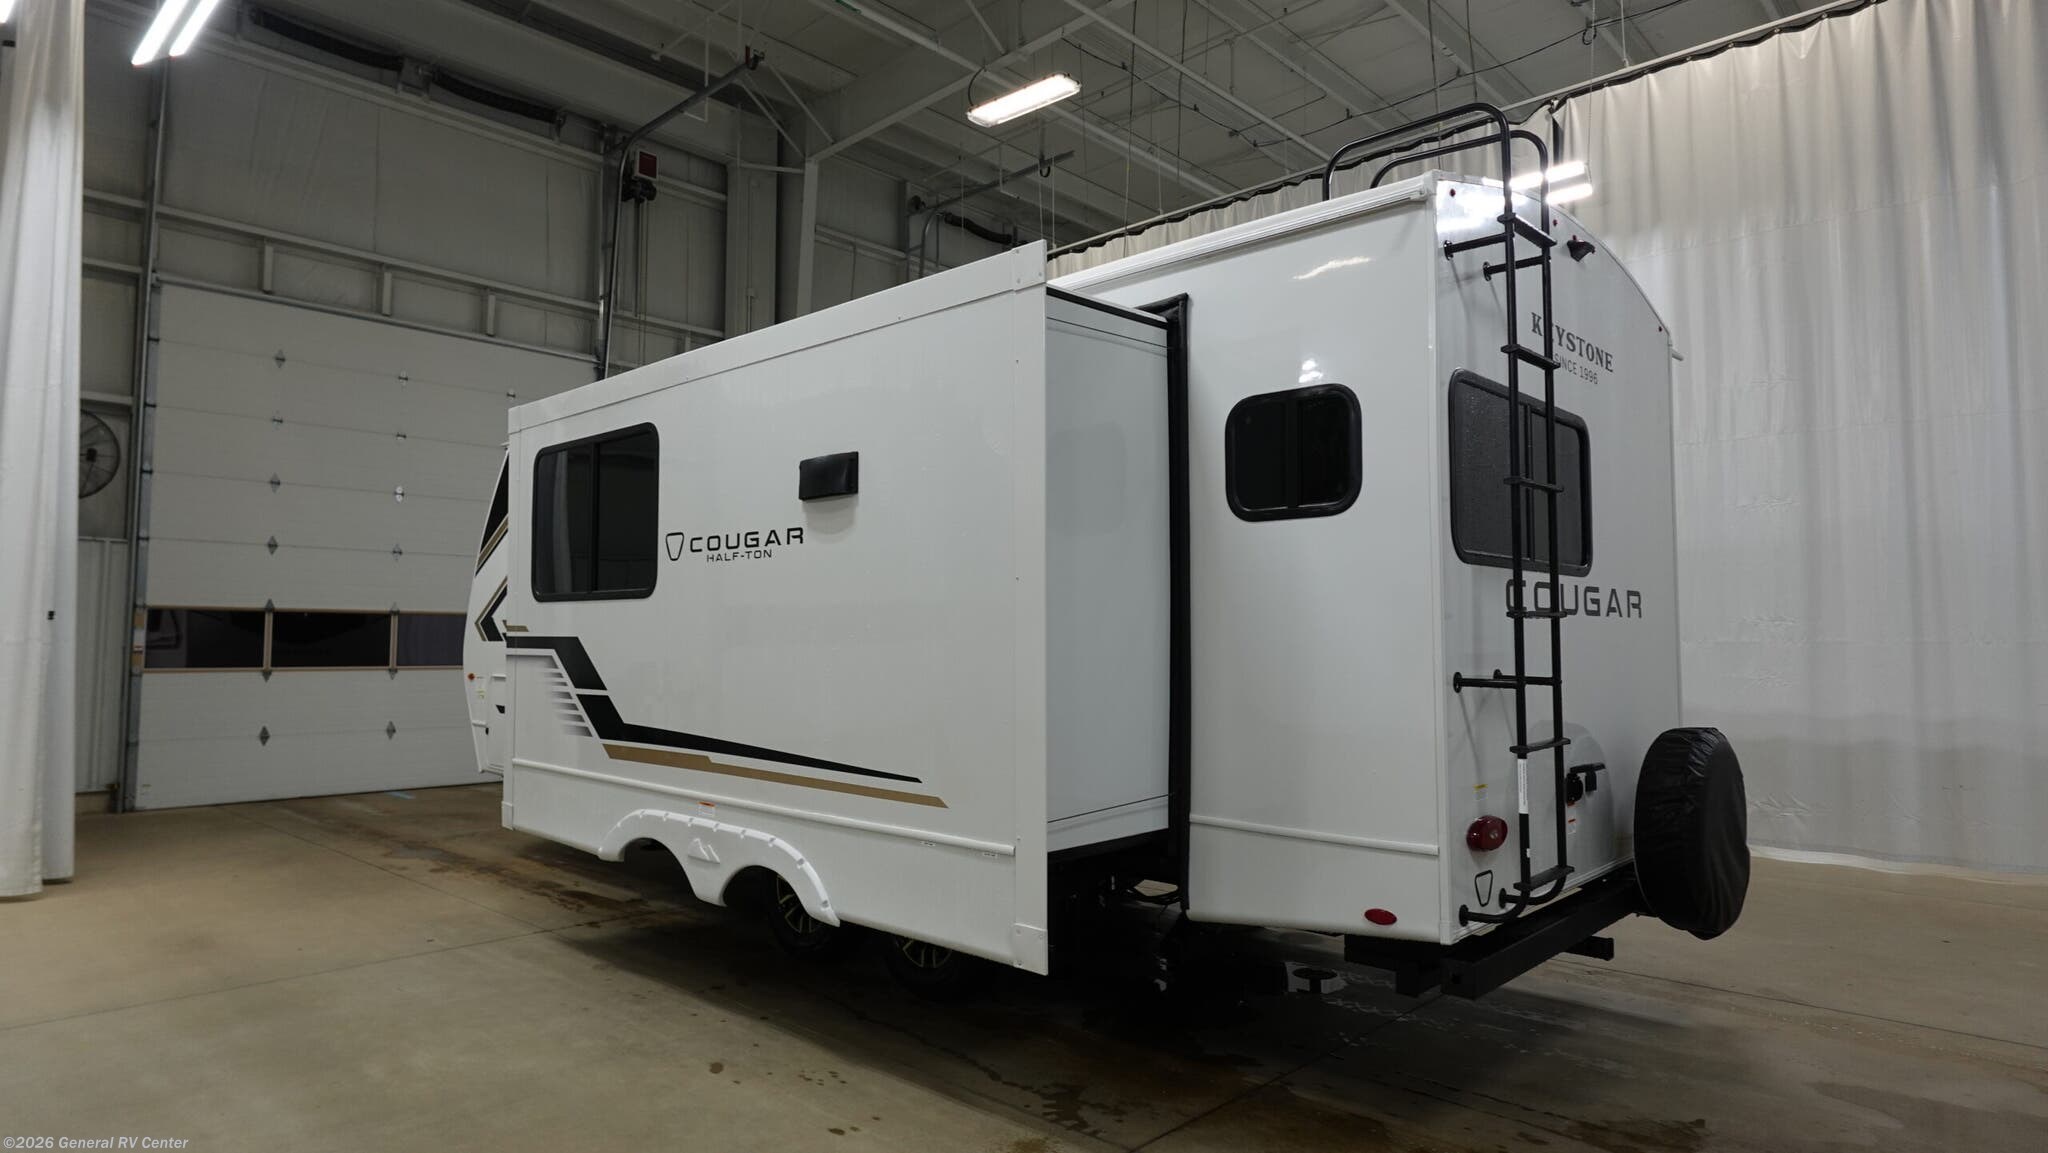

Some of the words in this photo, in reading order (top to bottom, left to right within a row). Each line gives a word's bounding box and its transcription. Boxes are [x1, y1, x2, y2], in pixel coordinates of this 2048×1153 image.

[1531, 312, 1614, 373] KYSTONE
[1579, 365, 1599, 385] 1996
[690, 527, 804, 553] COUGAR
[706, 549, 773, 563] HALF-TON
